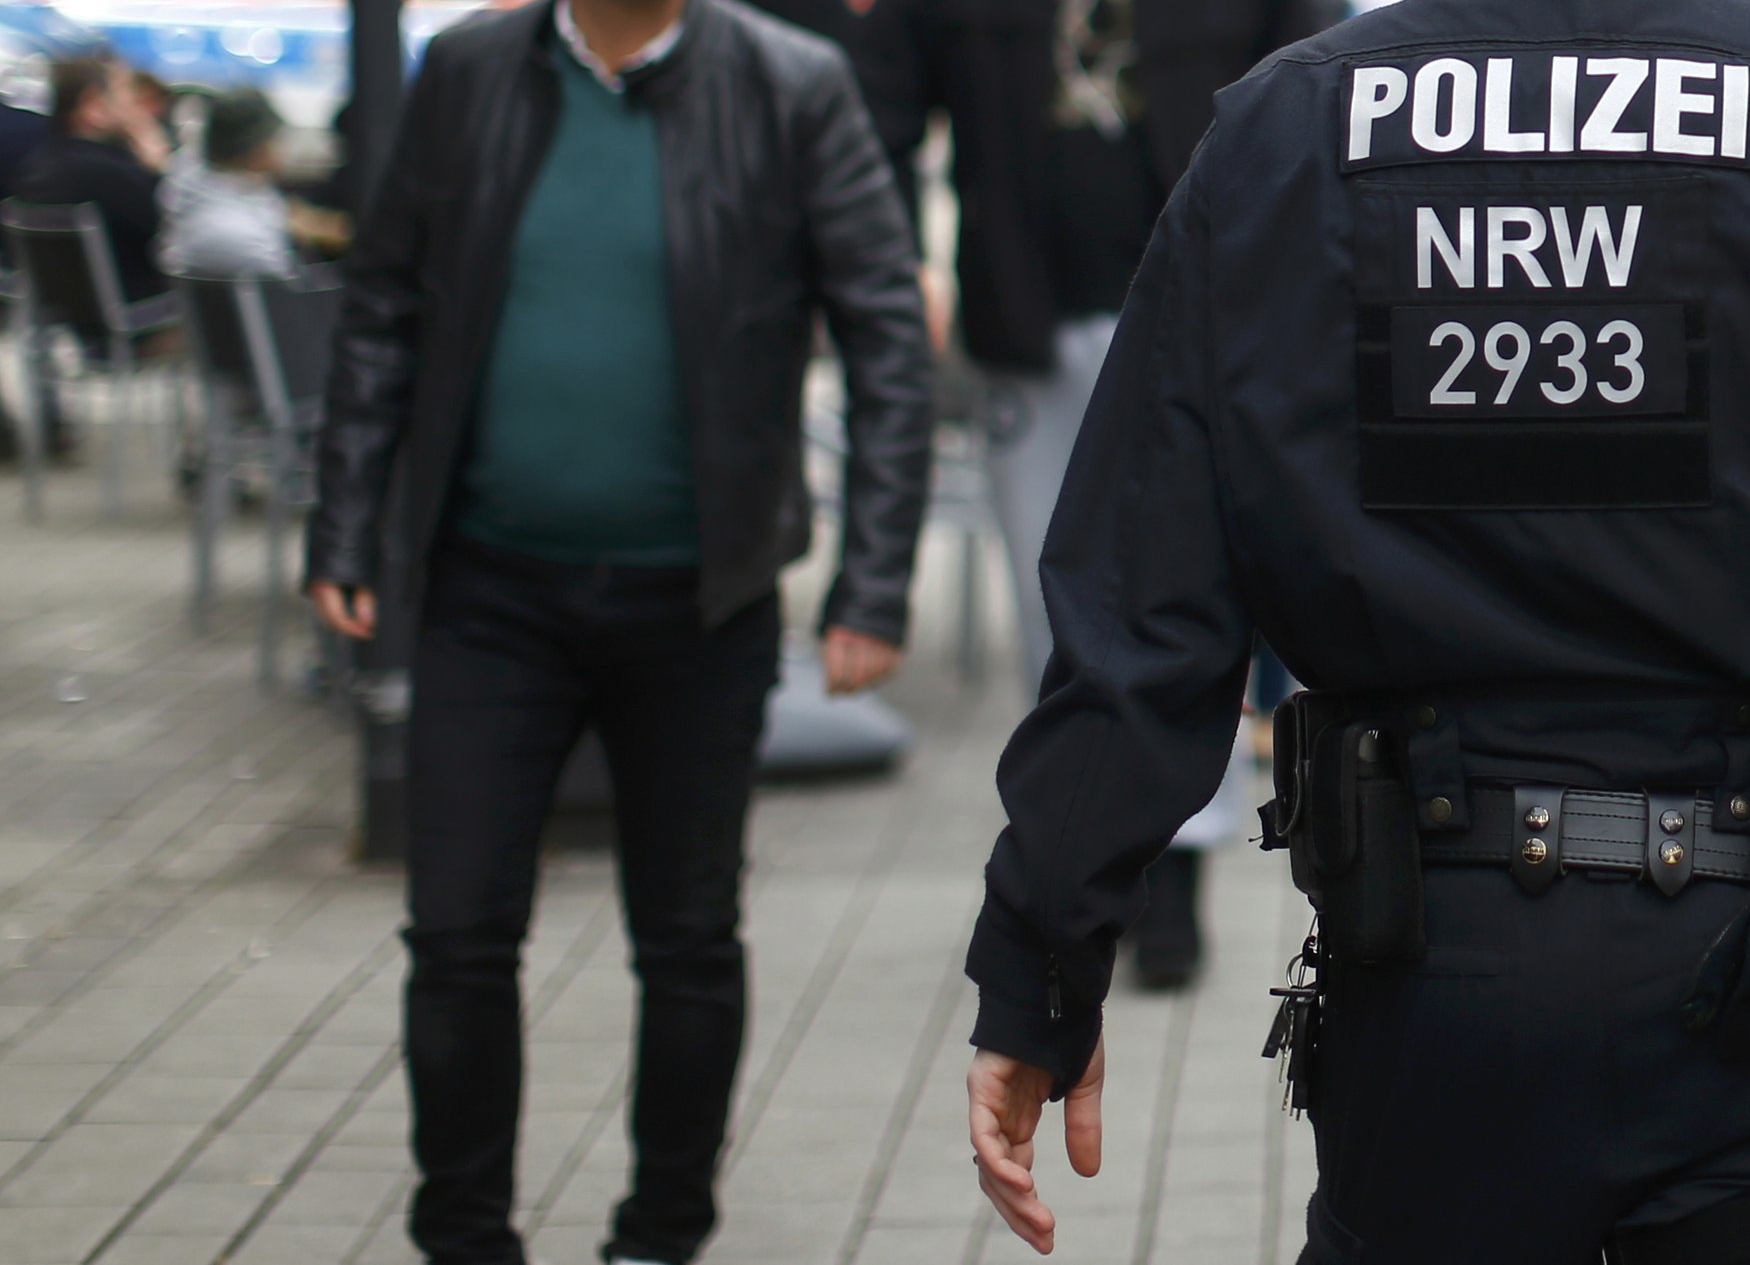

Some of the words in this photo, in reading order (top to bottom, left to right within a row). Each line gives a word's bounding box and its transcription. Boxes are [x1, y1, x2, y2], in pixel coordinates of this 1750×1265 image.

[1348, 56, 1750, 161] POLIZEI
[1416, 205, 1643, 289] NRW
[1428, 319, 1646, 406] 2933
